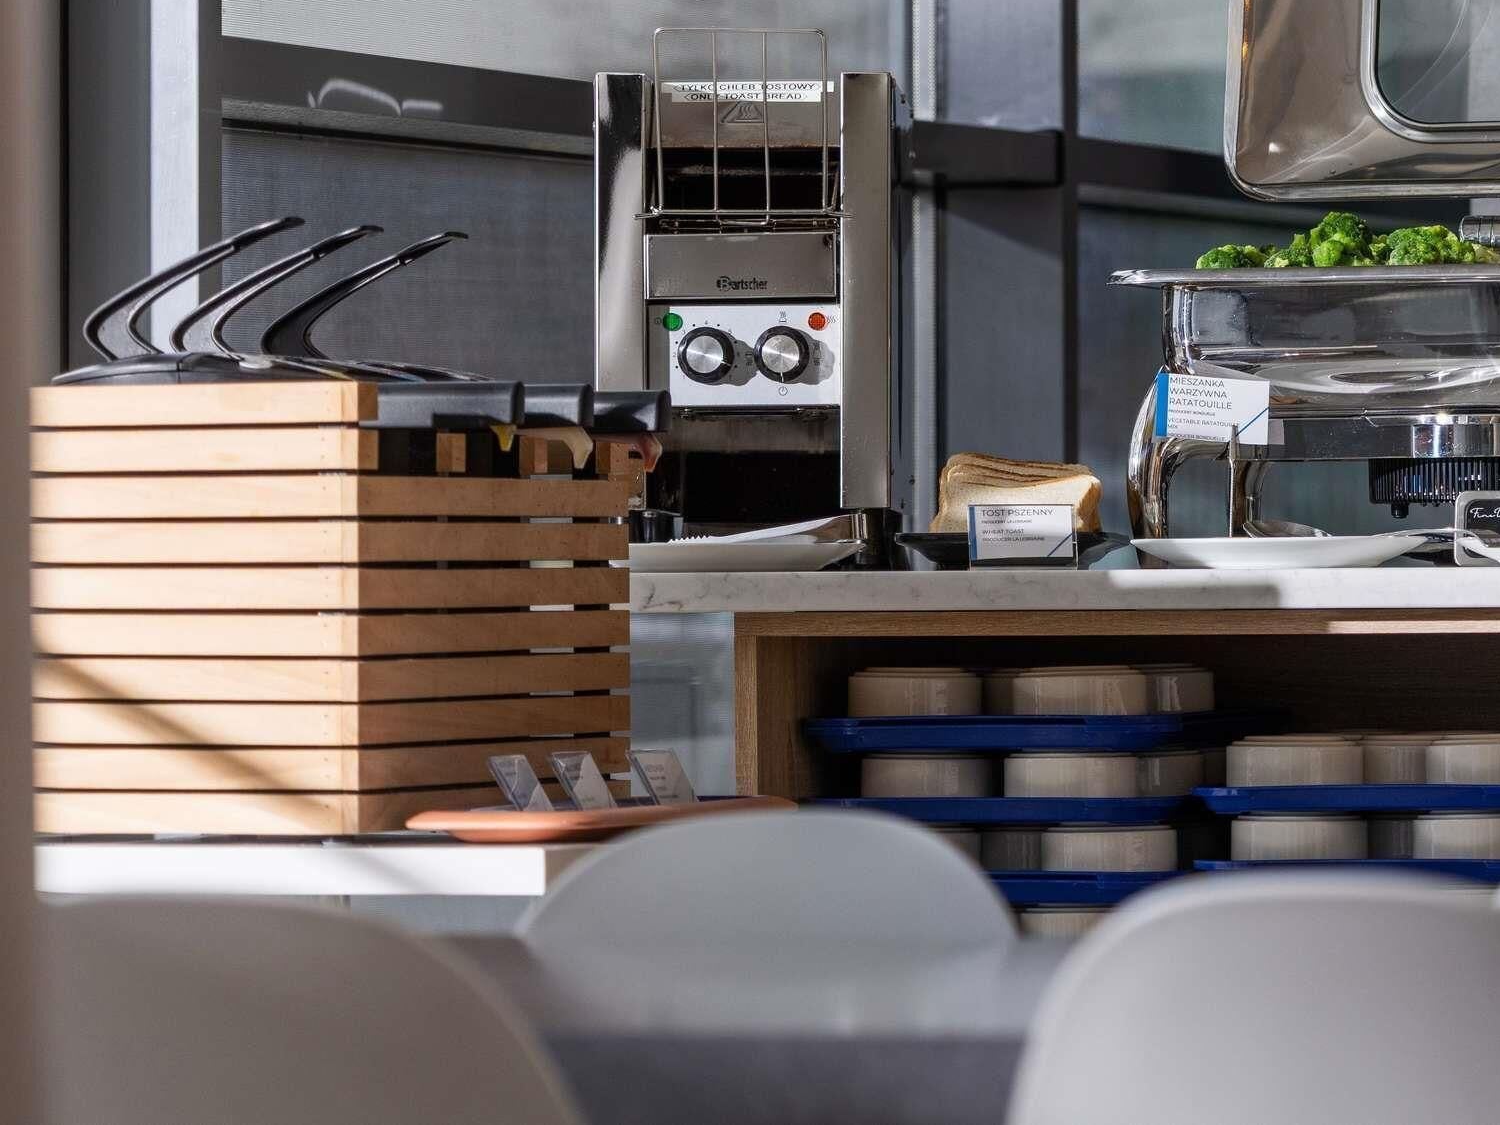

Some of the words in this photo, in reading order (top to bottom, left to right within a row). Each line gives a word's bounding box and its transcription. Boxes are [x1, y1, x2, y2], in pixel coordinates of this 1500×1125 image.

[716, 275, 768, 292] Bartscher
[1169, 377, 1225, 388] MIESZANKA
[1169, 388, 1228, 398] WARZYWNA
[1169, 398, 1233, 410] RATATOUILLE
[982, 508, 1005, 517] TOST
[1008, 508, 1054, 517] PSZENNY
